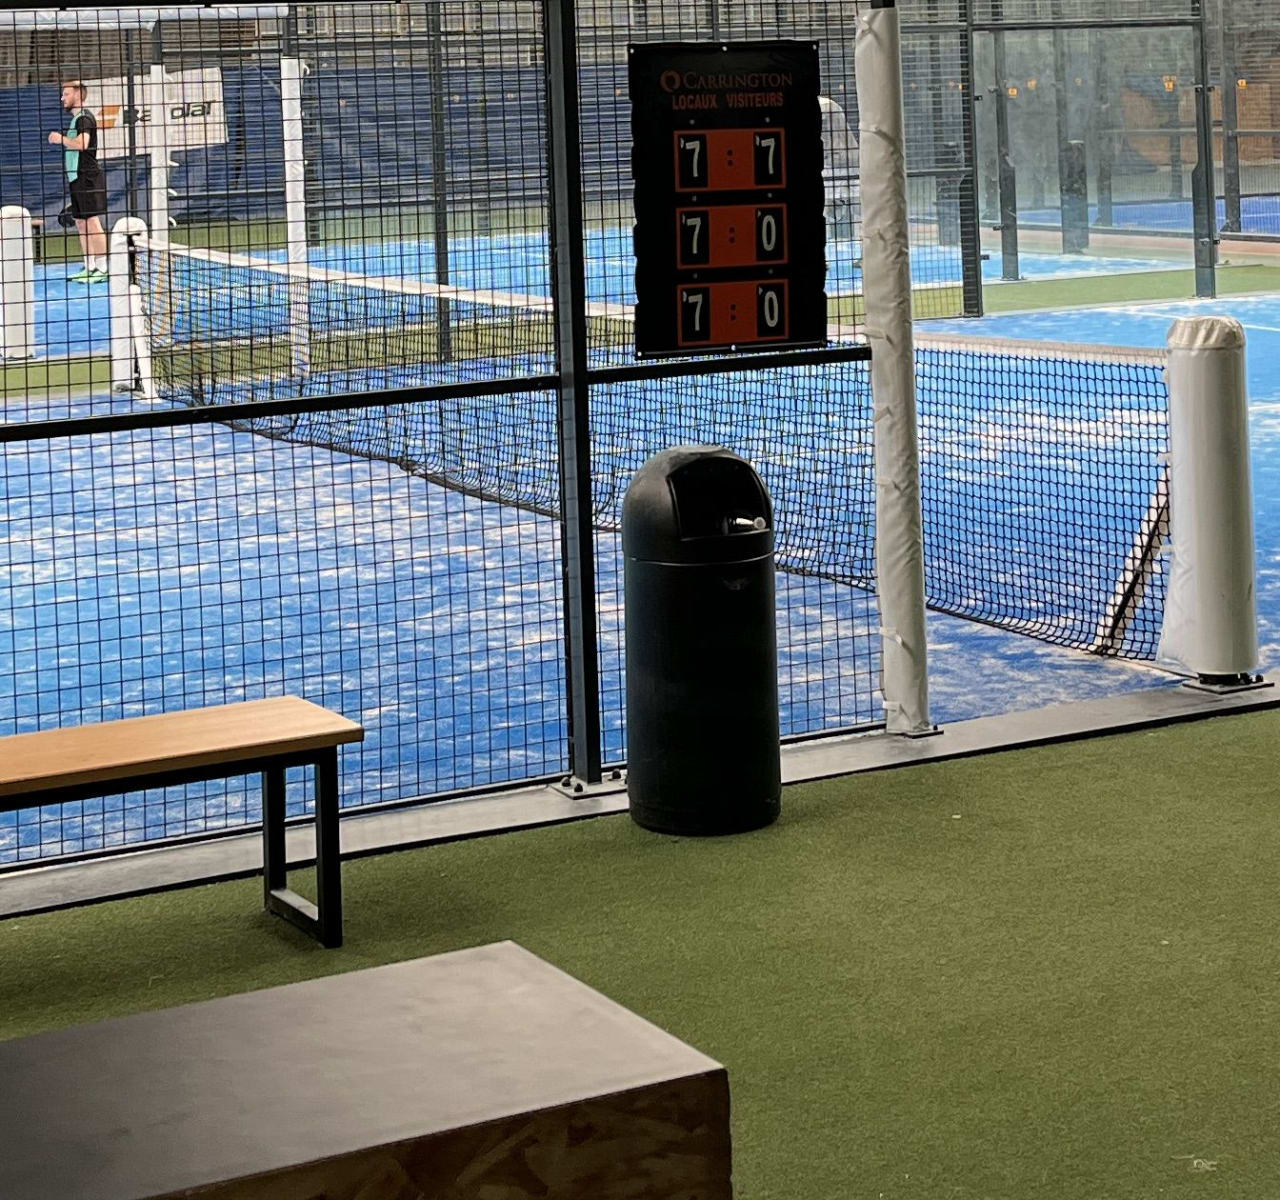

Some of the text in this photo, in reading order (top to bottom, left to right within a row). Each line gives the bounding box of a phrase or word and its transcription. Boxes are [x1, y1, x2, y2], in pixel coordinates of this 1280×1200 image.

[683, 72, 792, 89] CARRINGTON
[672, 92, 784, 110] LOCAUX VISITEURS
[686, 140, 700, 177] 7
[761, 138, 775, 174] 7
[686, 217, 701, 254] 7
[762, 215, 776, 251] 0
[688, 294, 703, 331] 7
[764, 291, 778, 327] 0
